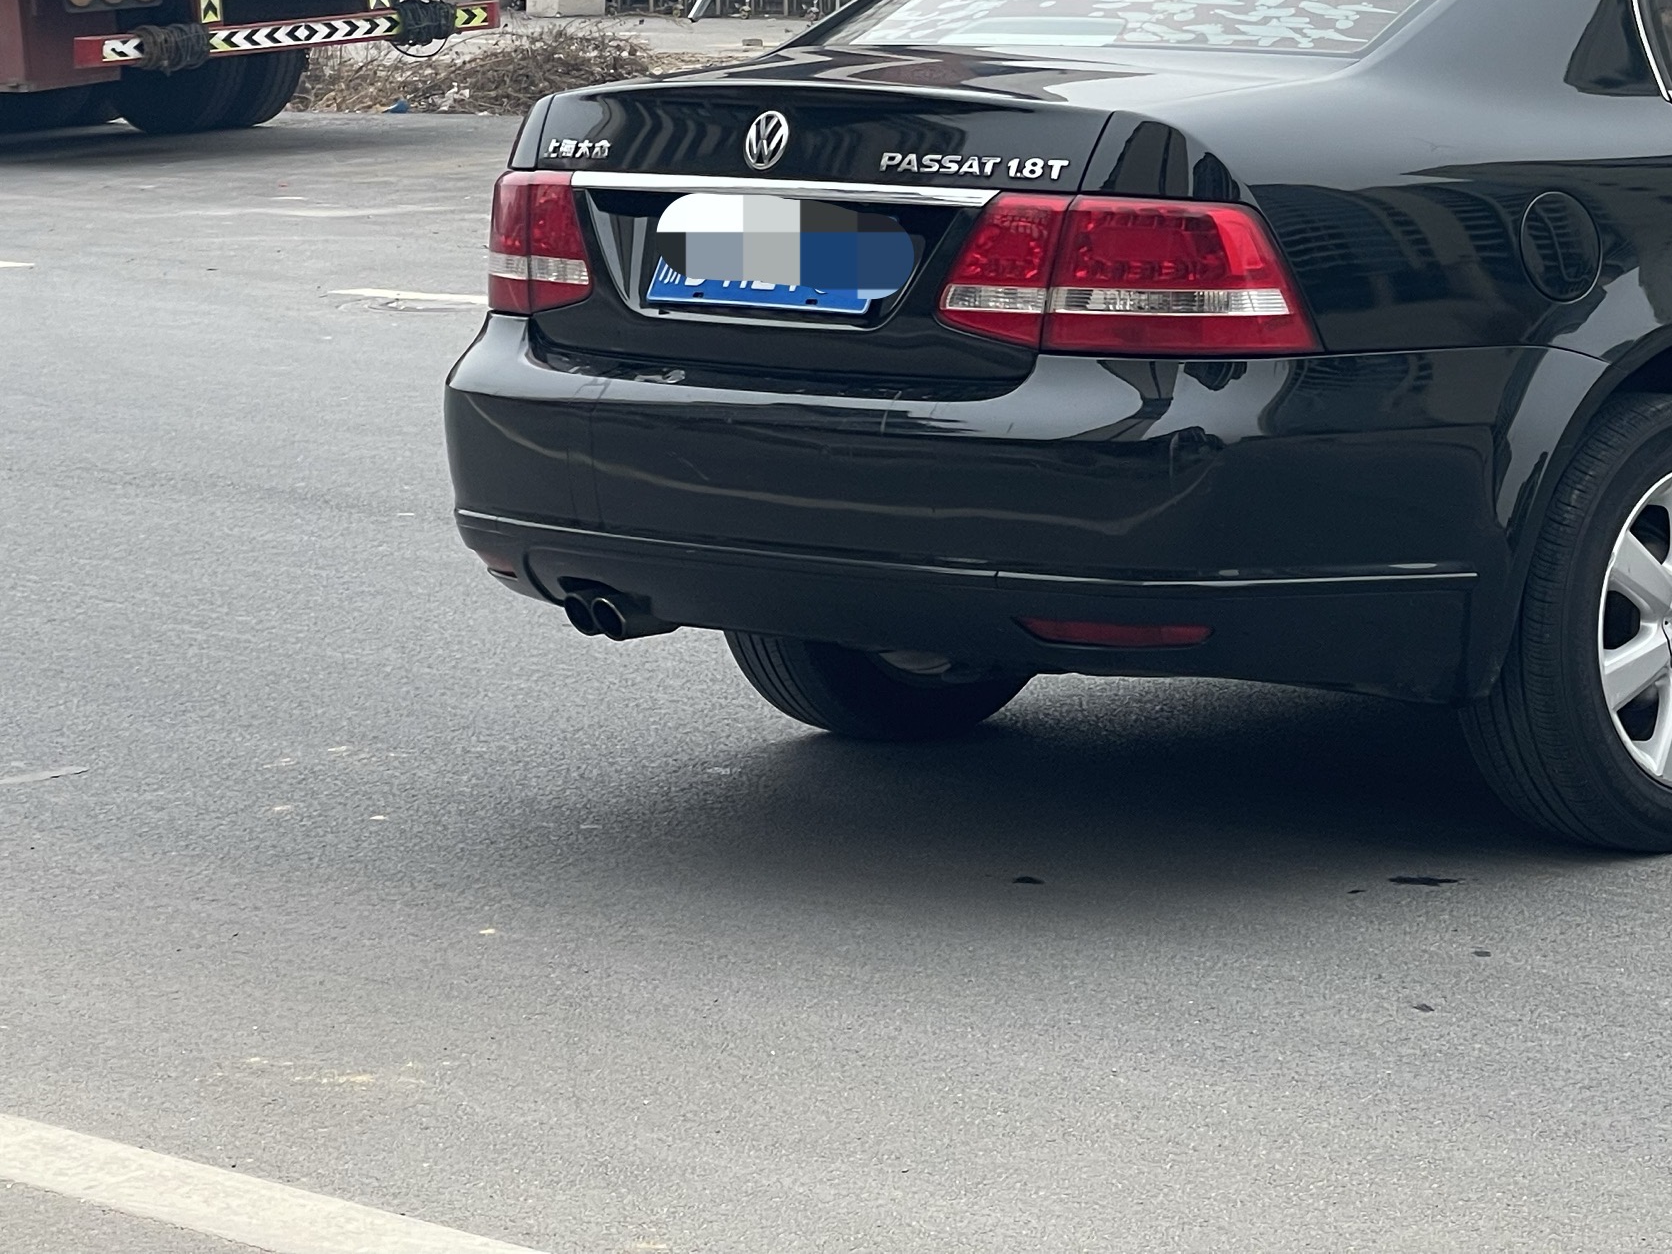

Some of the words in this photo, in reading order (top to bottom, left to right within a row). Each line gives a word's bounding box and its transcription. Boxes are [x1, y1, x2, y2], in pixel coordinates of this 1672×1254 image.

[543, 138, 612, 160] 上海大众
[879, 152, 1001, 177] PASSAT
[1007, 157, 1070, 180] 1.8T
